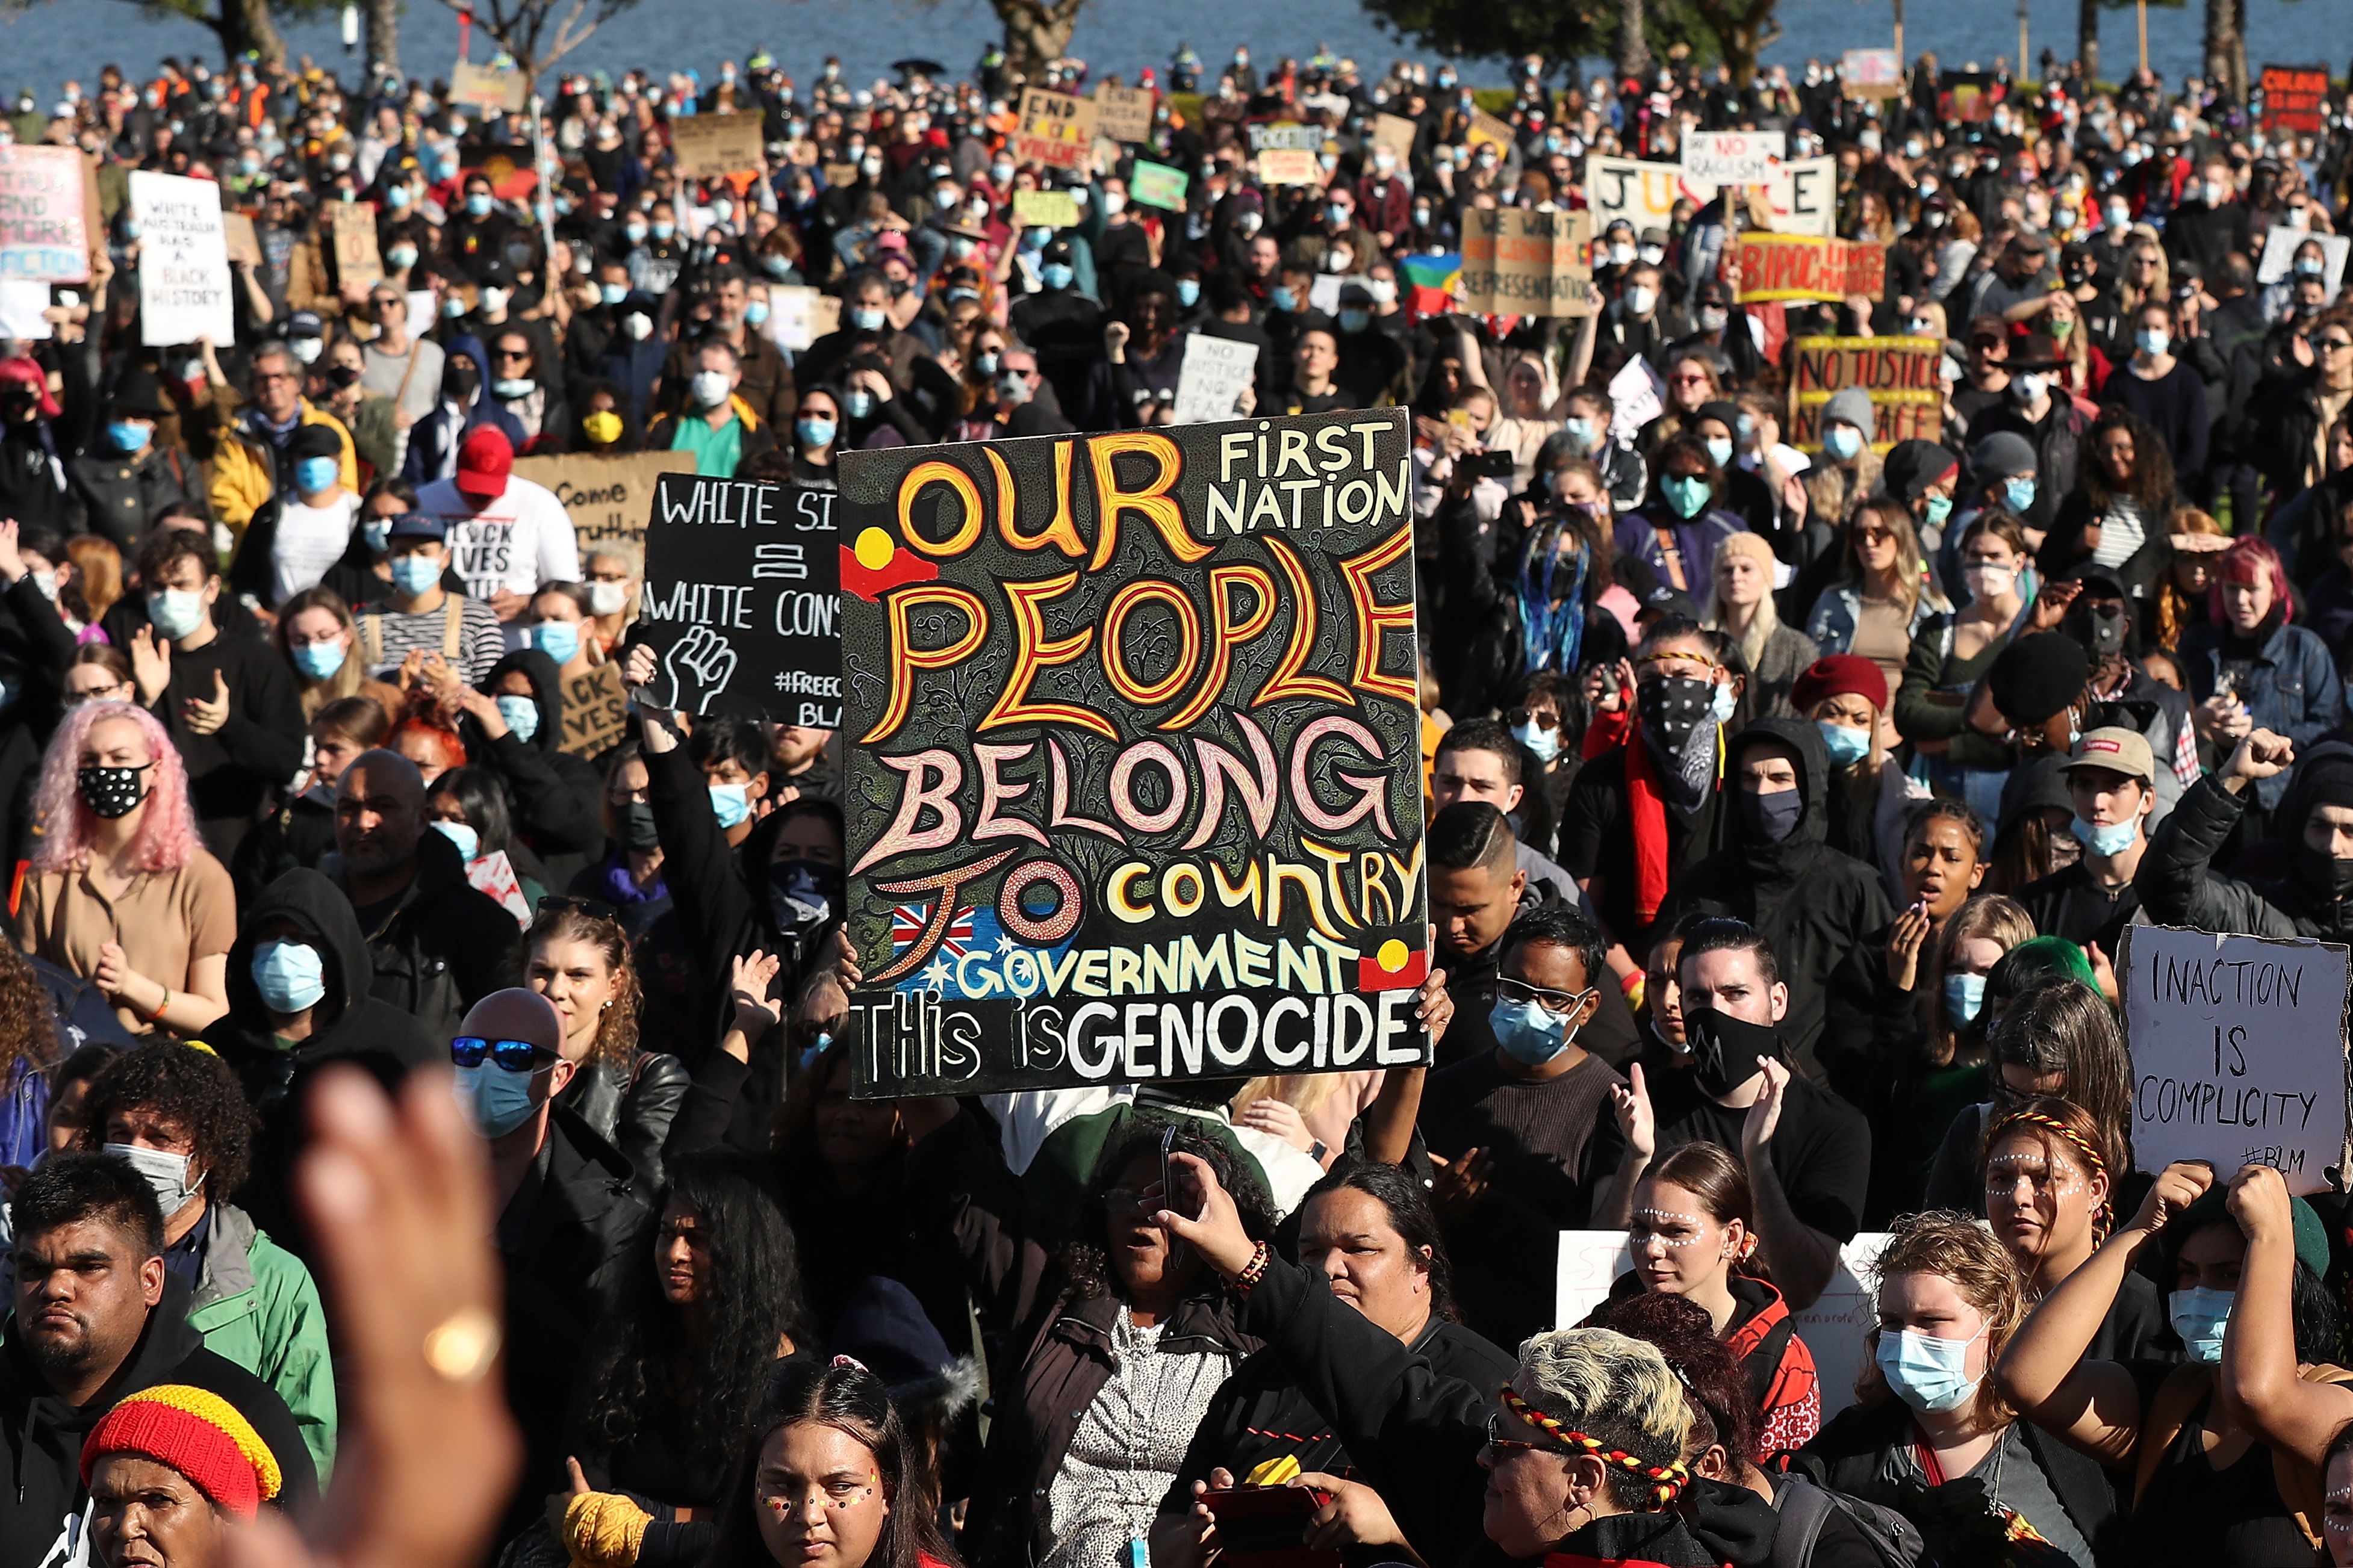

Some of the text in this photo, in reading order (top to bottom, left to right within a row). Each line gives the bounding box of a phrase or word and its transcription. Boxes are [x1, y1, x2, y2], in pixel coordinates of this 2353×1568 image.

[1028, 95, 1076, 118] END
[1689, 158, 1765, 179] RACISM
[1715, 137, 1747, 156] NO
[150, 199, 198, 219] WHITE
[1479, 213, 1577, 238] WE WANT
[160, 234, 194, 247] HAS
[175, 250, 184, 261] A
[163, 267, 209, 284] BLACK
[1741, 244, 1820, 293] BIPOC
[1204, 344, 1234, 361] NO
[1800, 348, 1942, 391] NO JUSTICE
[1196, 379, 1228, 395] NO
[1220, 420, 1393, 482] FiRST
[555, 482, 626, 507] Come
[660, 480, 780, 529] WHITE
[898, 432, 1215, 572] OUR
[1206, 458, 1409, 536] NATiON
[645, 580, 755, 630] WHITE
[859, 524, 1416, 745] PEOPLE
[848, 710, 1397, 878] BELONG
[866, 846, 1083, 984] TO
[955, 927, 1361, 999] GOVERNMENT
[2152, 950, 2304, 1008] INACTION
[1067, 988, 1421, 1079] GENOCIDE
[2214, 1024, 2247, 1077] IS
[2138, 1074, 2317, 1132] COMPLICITY
[2241, 1145, 2305, 1174] #BLM
